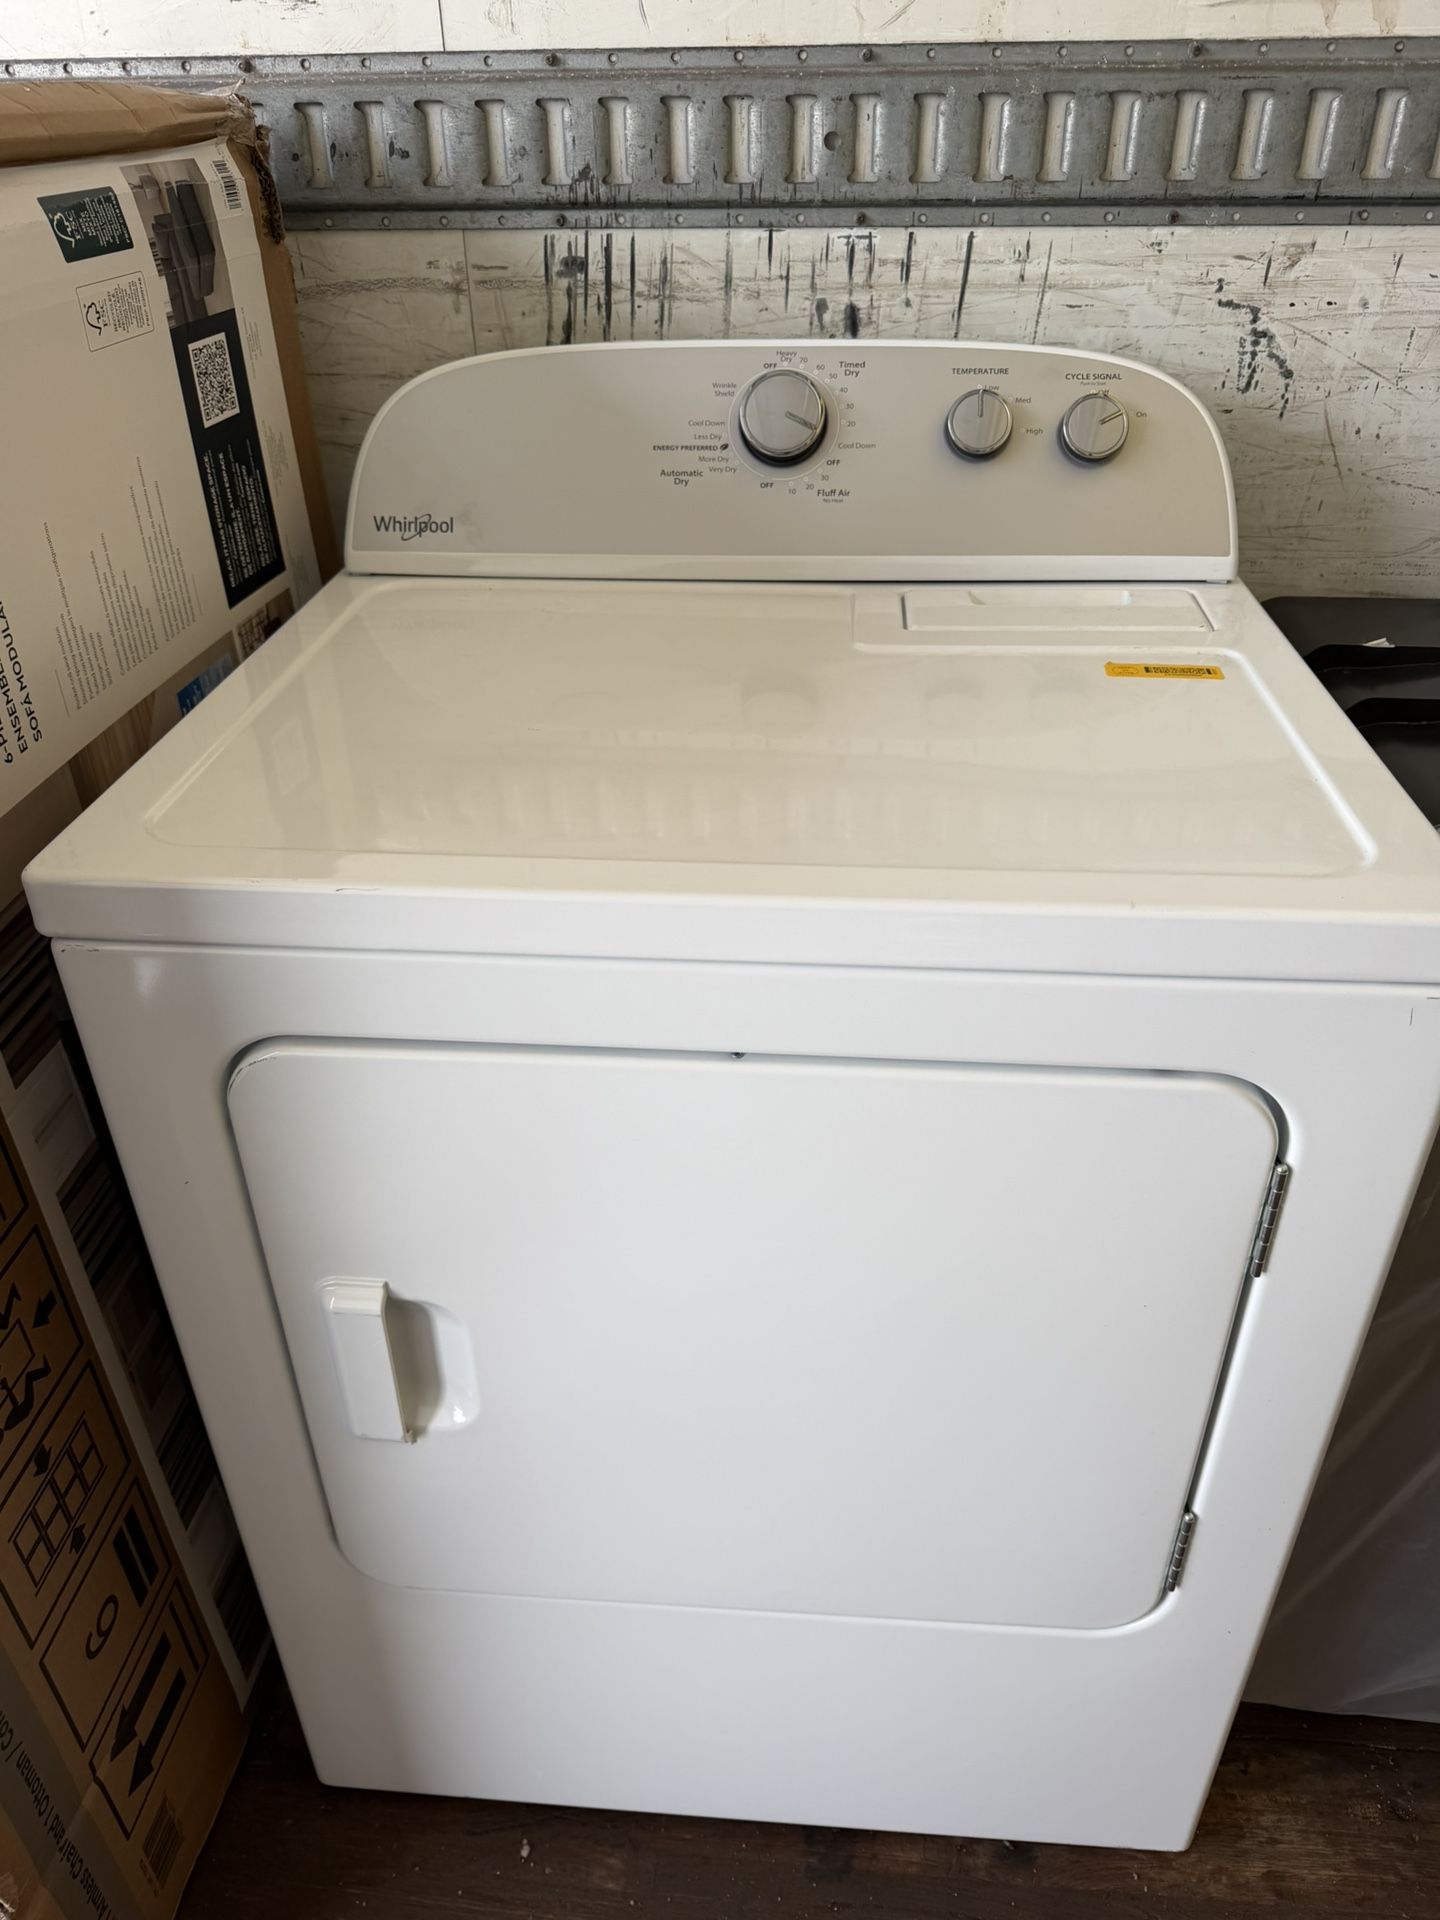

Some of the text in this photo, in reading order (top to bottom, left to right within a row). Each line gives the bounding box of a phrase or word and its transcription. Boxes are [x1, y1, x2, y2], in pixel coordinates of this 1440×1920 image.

[844, 369, 859, 377] Dry
[710, 433, 722, 441] Dry
[717, 456, 729, 464] Dry
[660, 469, 703, 477] Automatic
[674, 477, 689, 487] Dry
[373, 514, 454, 539] Whirlpool
[0, 600, 43, 742] SOFÁ MODULA
[16, 1750, 51, 1818] Ottoman
[47, 1814, 67, 1845] and
[57, 1839, 84, 1881] Chair
